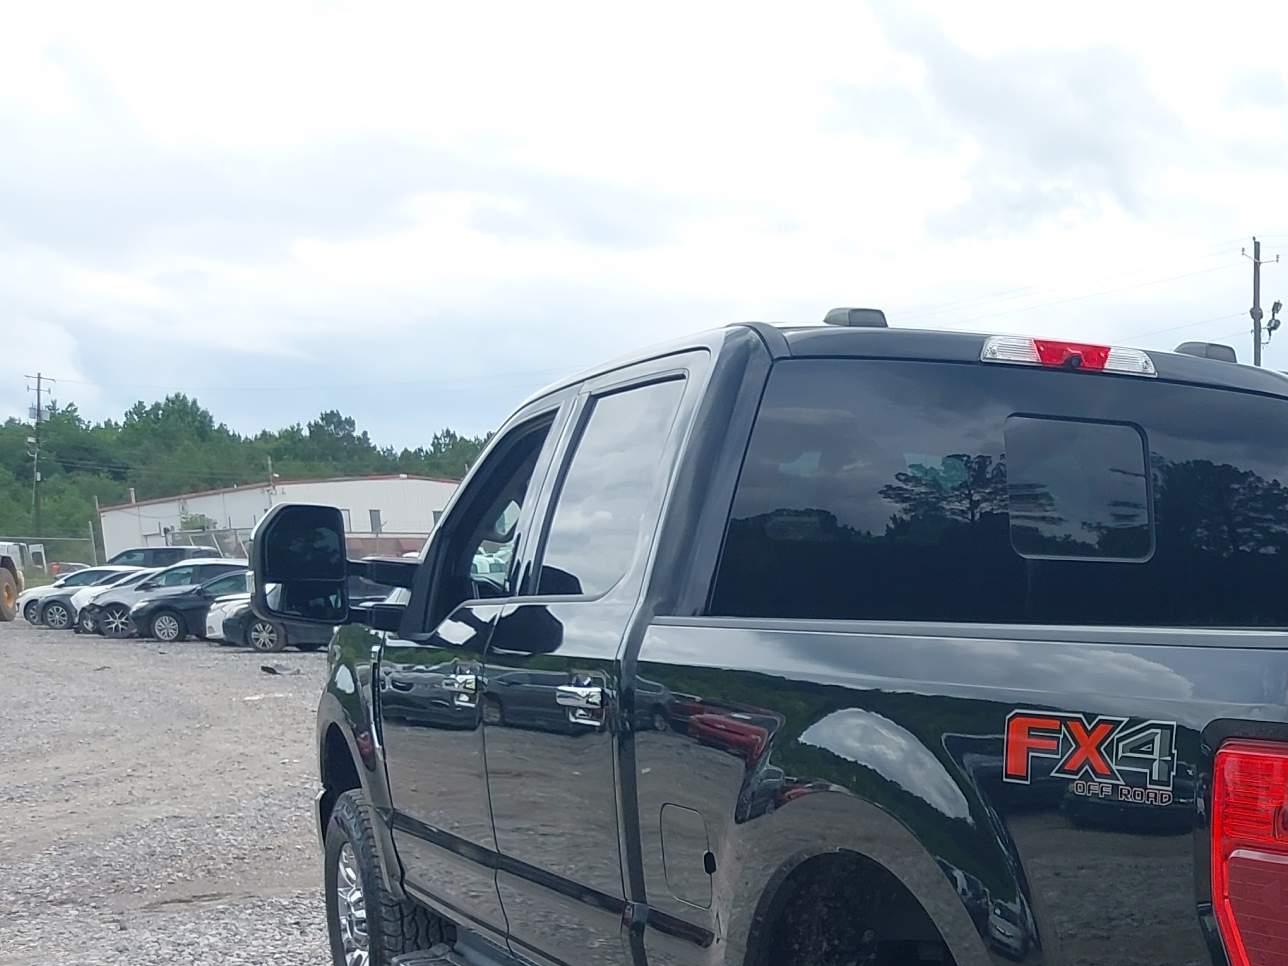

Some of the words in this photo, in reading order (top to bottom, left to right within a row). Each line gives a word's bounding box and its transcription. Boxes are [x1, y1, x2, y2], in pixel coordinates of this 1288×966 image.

[1003, 709, 1177, 790] FX4
[1073, 780, 1113, 798] OFF
[1119, 785, 1173, 806] ROAD
